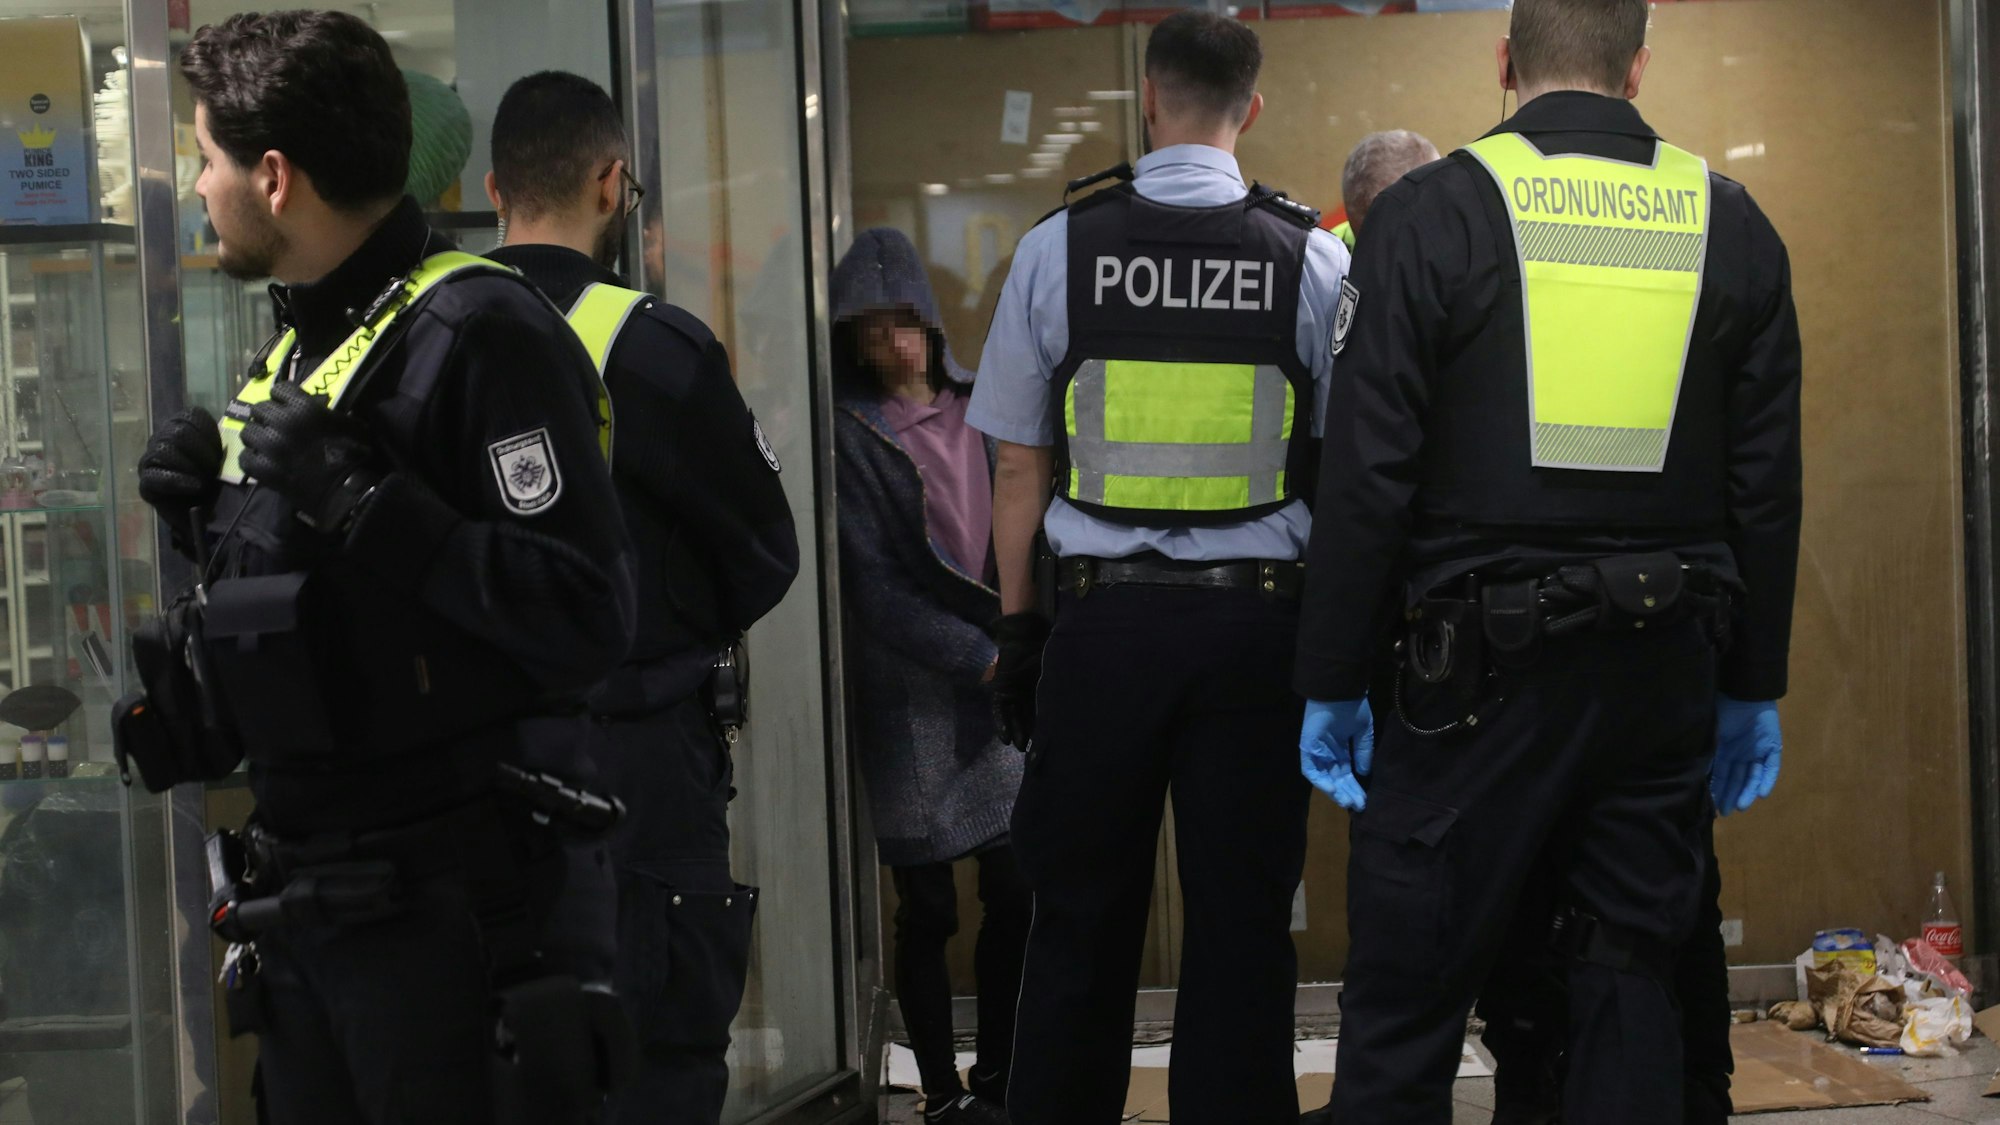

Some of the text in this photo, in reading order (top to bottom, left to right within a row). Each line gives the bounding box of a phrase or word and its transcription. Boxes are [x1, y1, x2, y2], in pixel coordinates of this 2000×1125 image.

[24, 153, 54, 167] KING
[8, 168, 70, 179] TWO SIDED
[20, 180, 63, 191] PUMICE
[1513, 176, 1698, 225] ORDNUNGSAMT
[1094, 255, 1274, 311] POLIZEI
